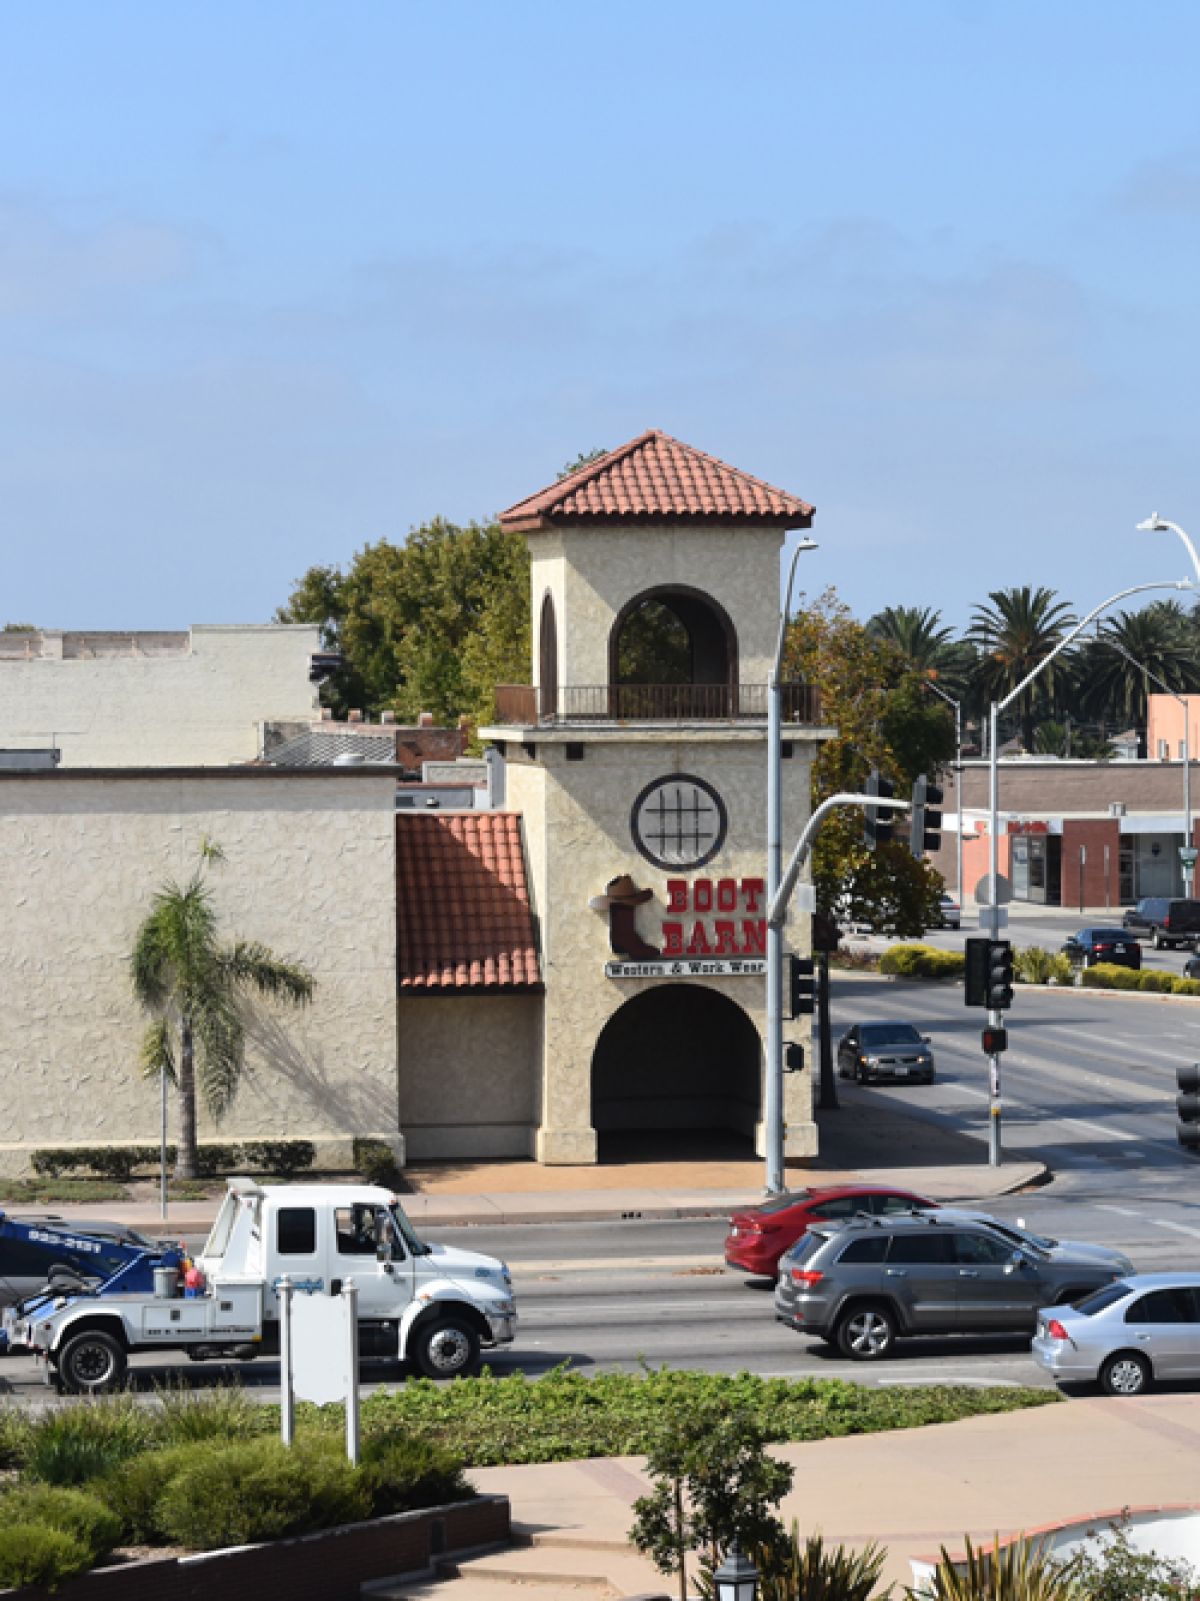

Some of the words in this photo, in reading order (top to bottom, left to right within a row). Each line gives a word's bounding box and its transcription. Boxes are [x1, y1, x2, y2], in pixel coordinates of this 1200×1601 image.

[667, 878, 764, 912] BOOT
[662, 919, 768, 956] BARN
[611, 964, 663, 976] Western
